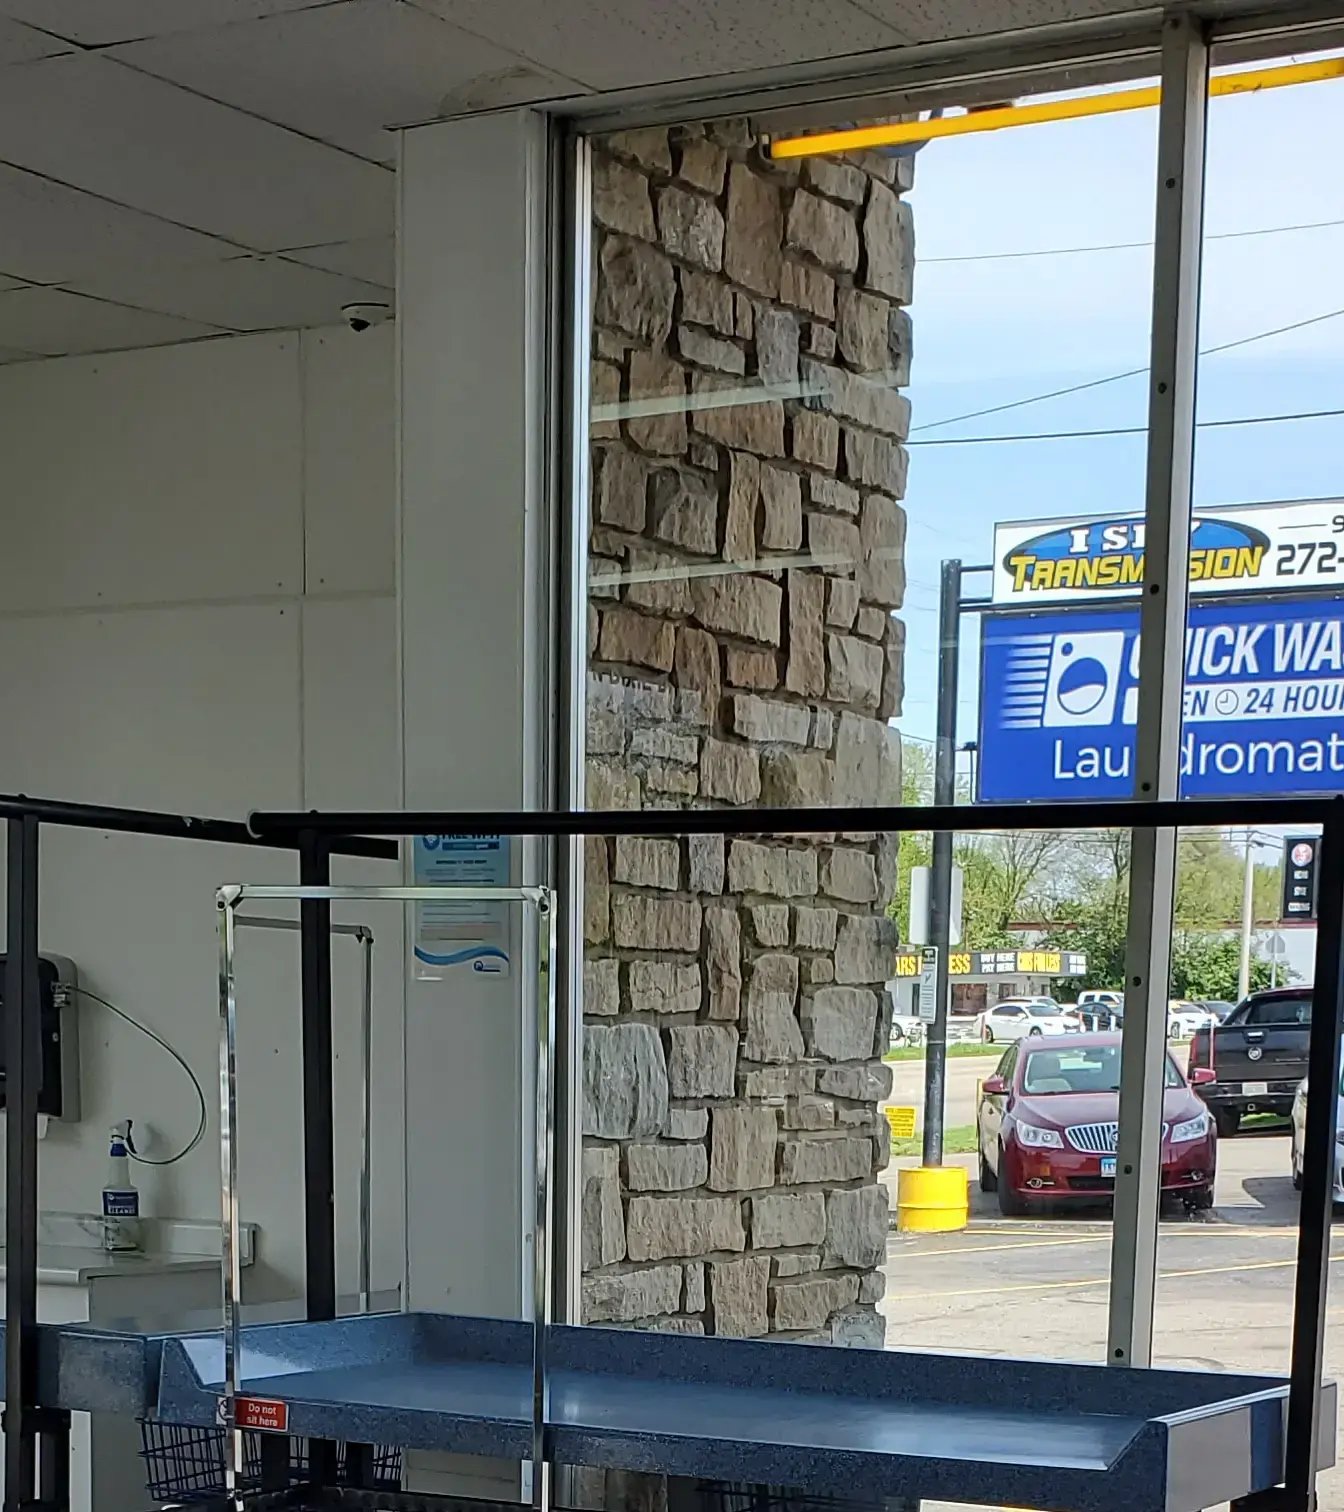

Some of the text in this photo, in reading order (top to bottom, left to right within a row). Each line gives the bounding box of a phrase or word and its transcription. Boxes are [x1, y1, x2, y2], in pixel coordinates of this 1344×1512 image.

[1009, 544, 1265, 592] TRANSMSION
[1129, 621, 1272, 681] ICK
[1243, 687, 1274, 713] 24
[948, 953, 971, 974] ESS
[248, 1403, 277, 1416] Do not
[259, 1415, 278, 1427] here
